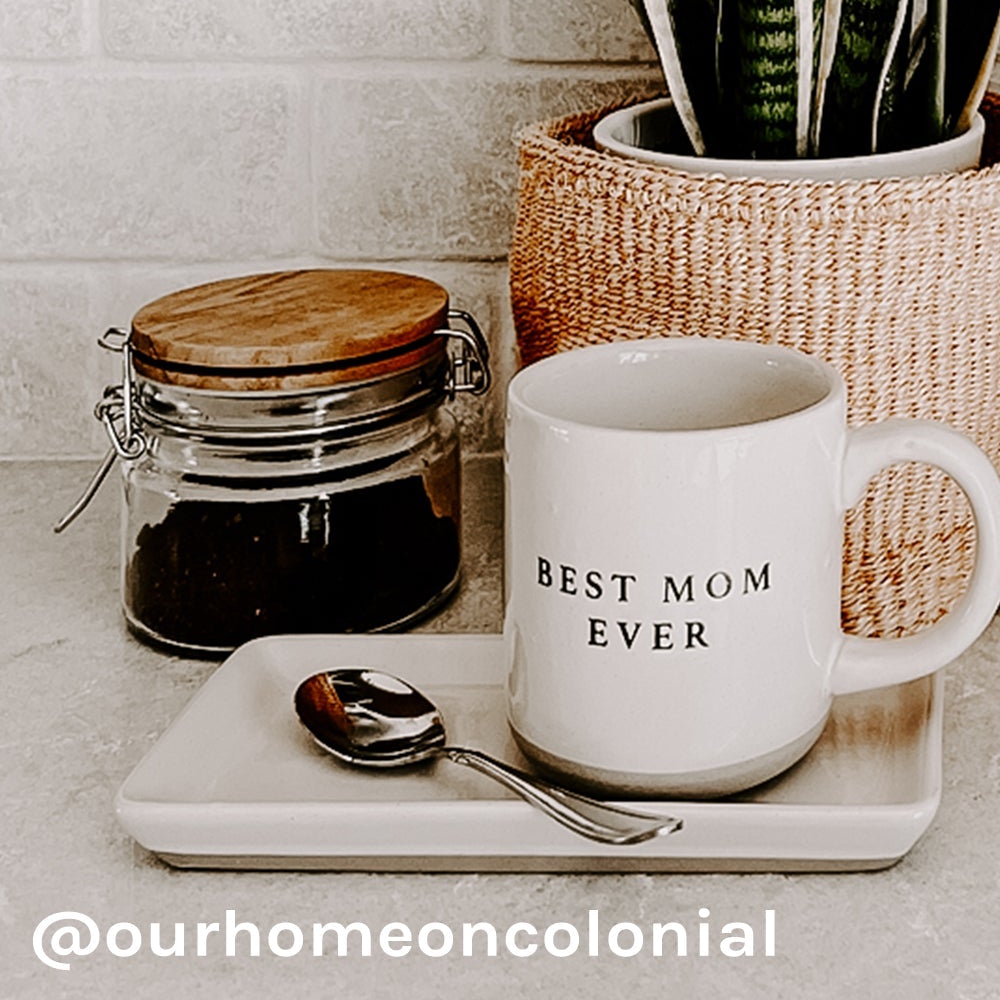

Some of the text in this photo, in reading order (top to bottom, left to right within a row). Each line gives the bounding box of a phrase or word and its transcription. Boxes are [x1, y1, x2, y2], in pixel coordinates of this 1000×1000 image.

[537, 556, 770, 603] BEST MOM
[587, 617, 709, 651] EVER
